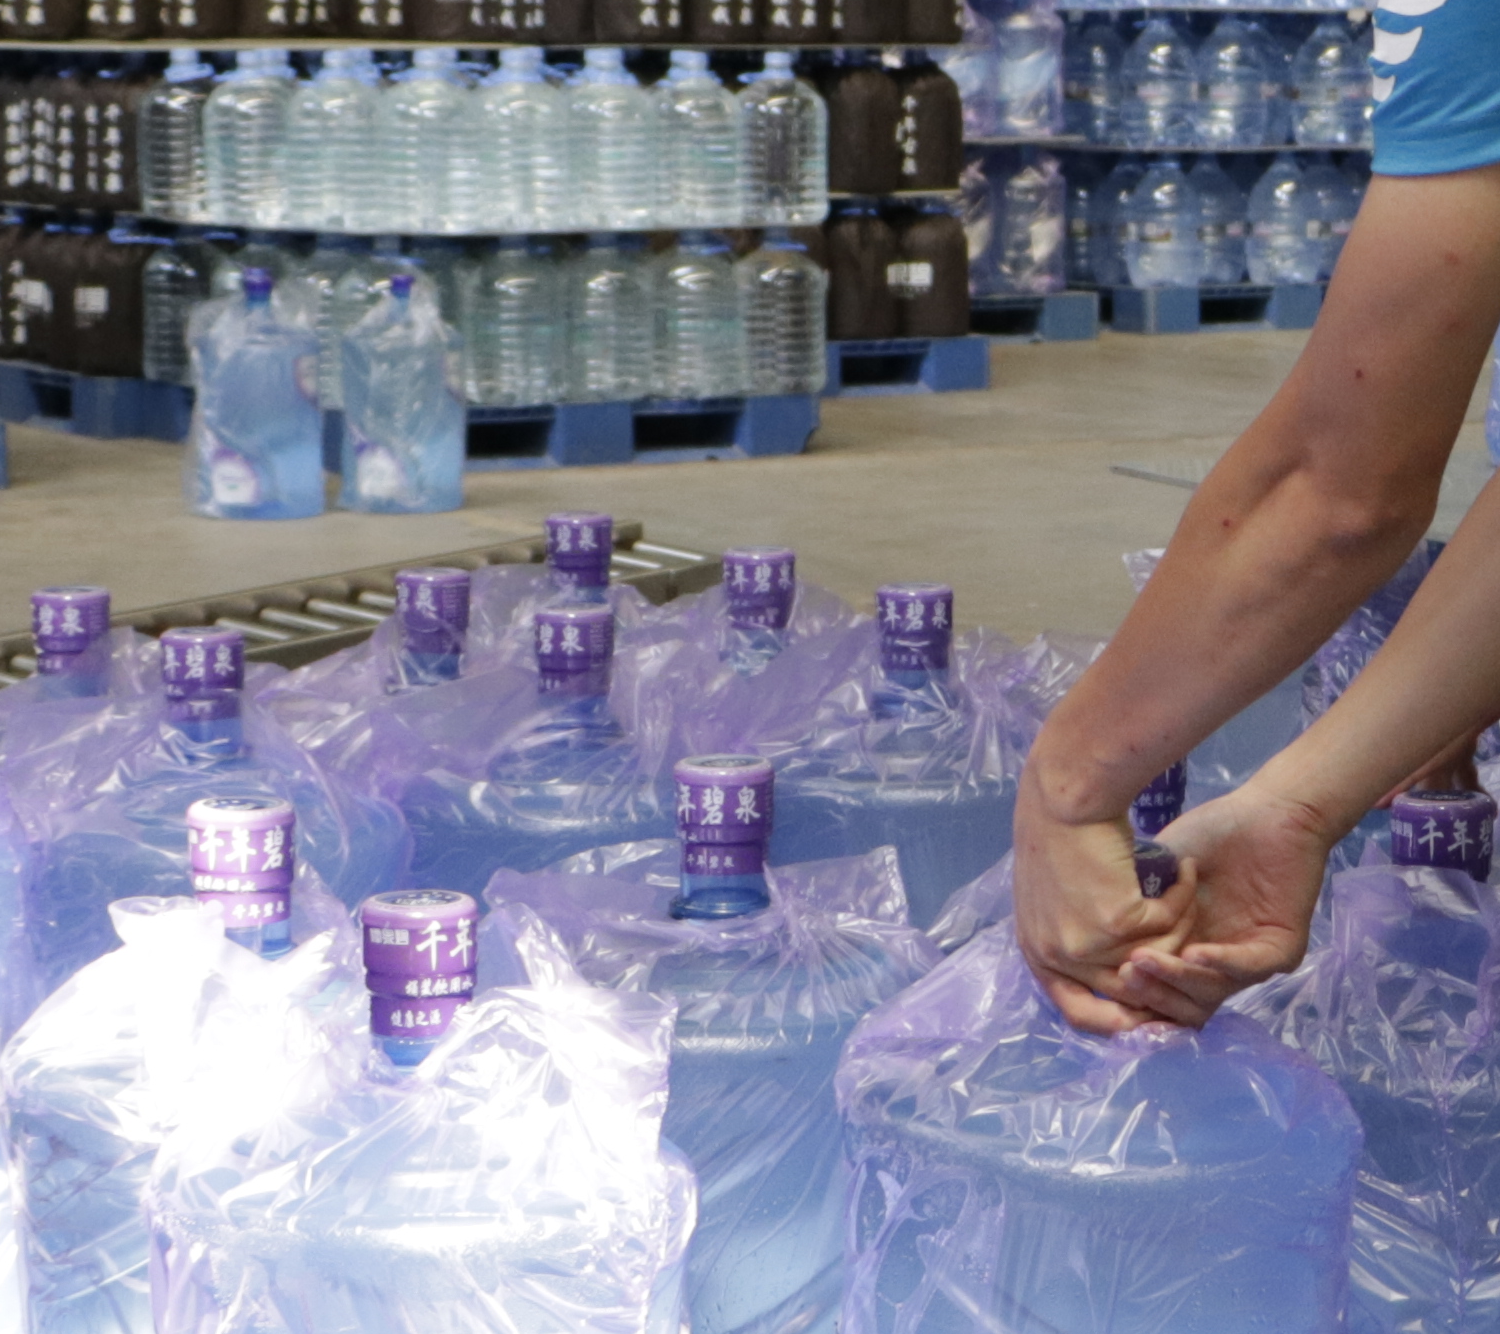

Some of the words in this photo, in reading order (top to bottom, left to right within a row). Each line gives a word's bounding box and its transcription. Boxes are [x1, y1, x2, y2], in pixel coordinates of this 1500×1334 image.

[877, 599, 950, 632] 年碧泉
[415, 919, 474, 972] 千年
